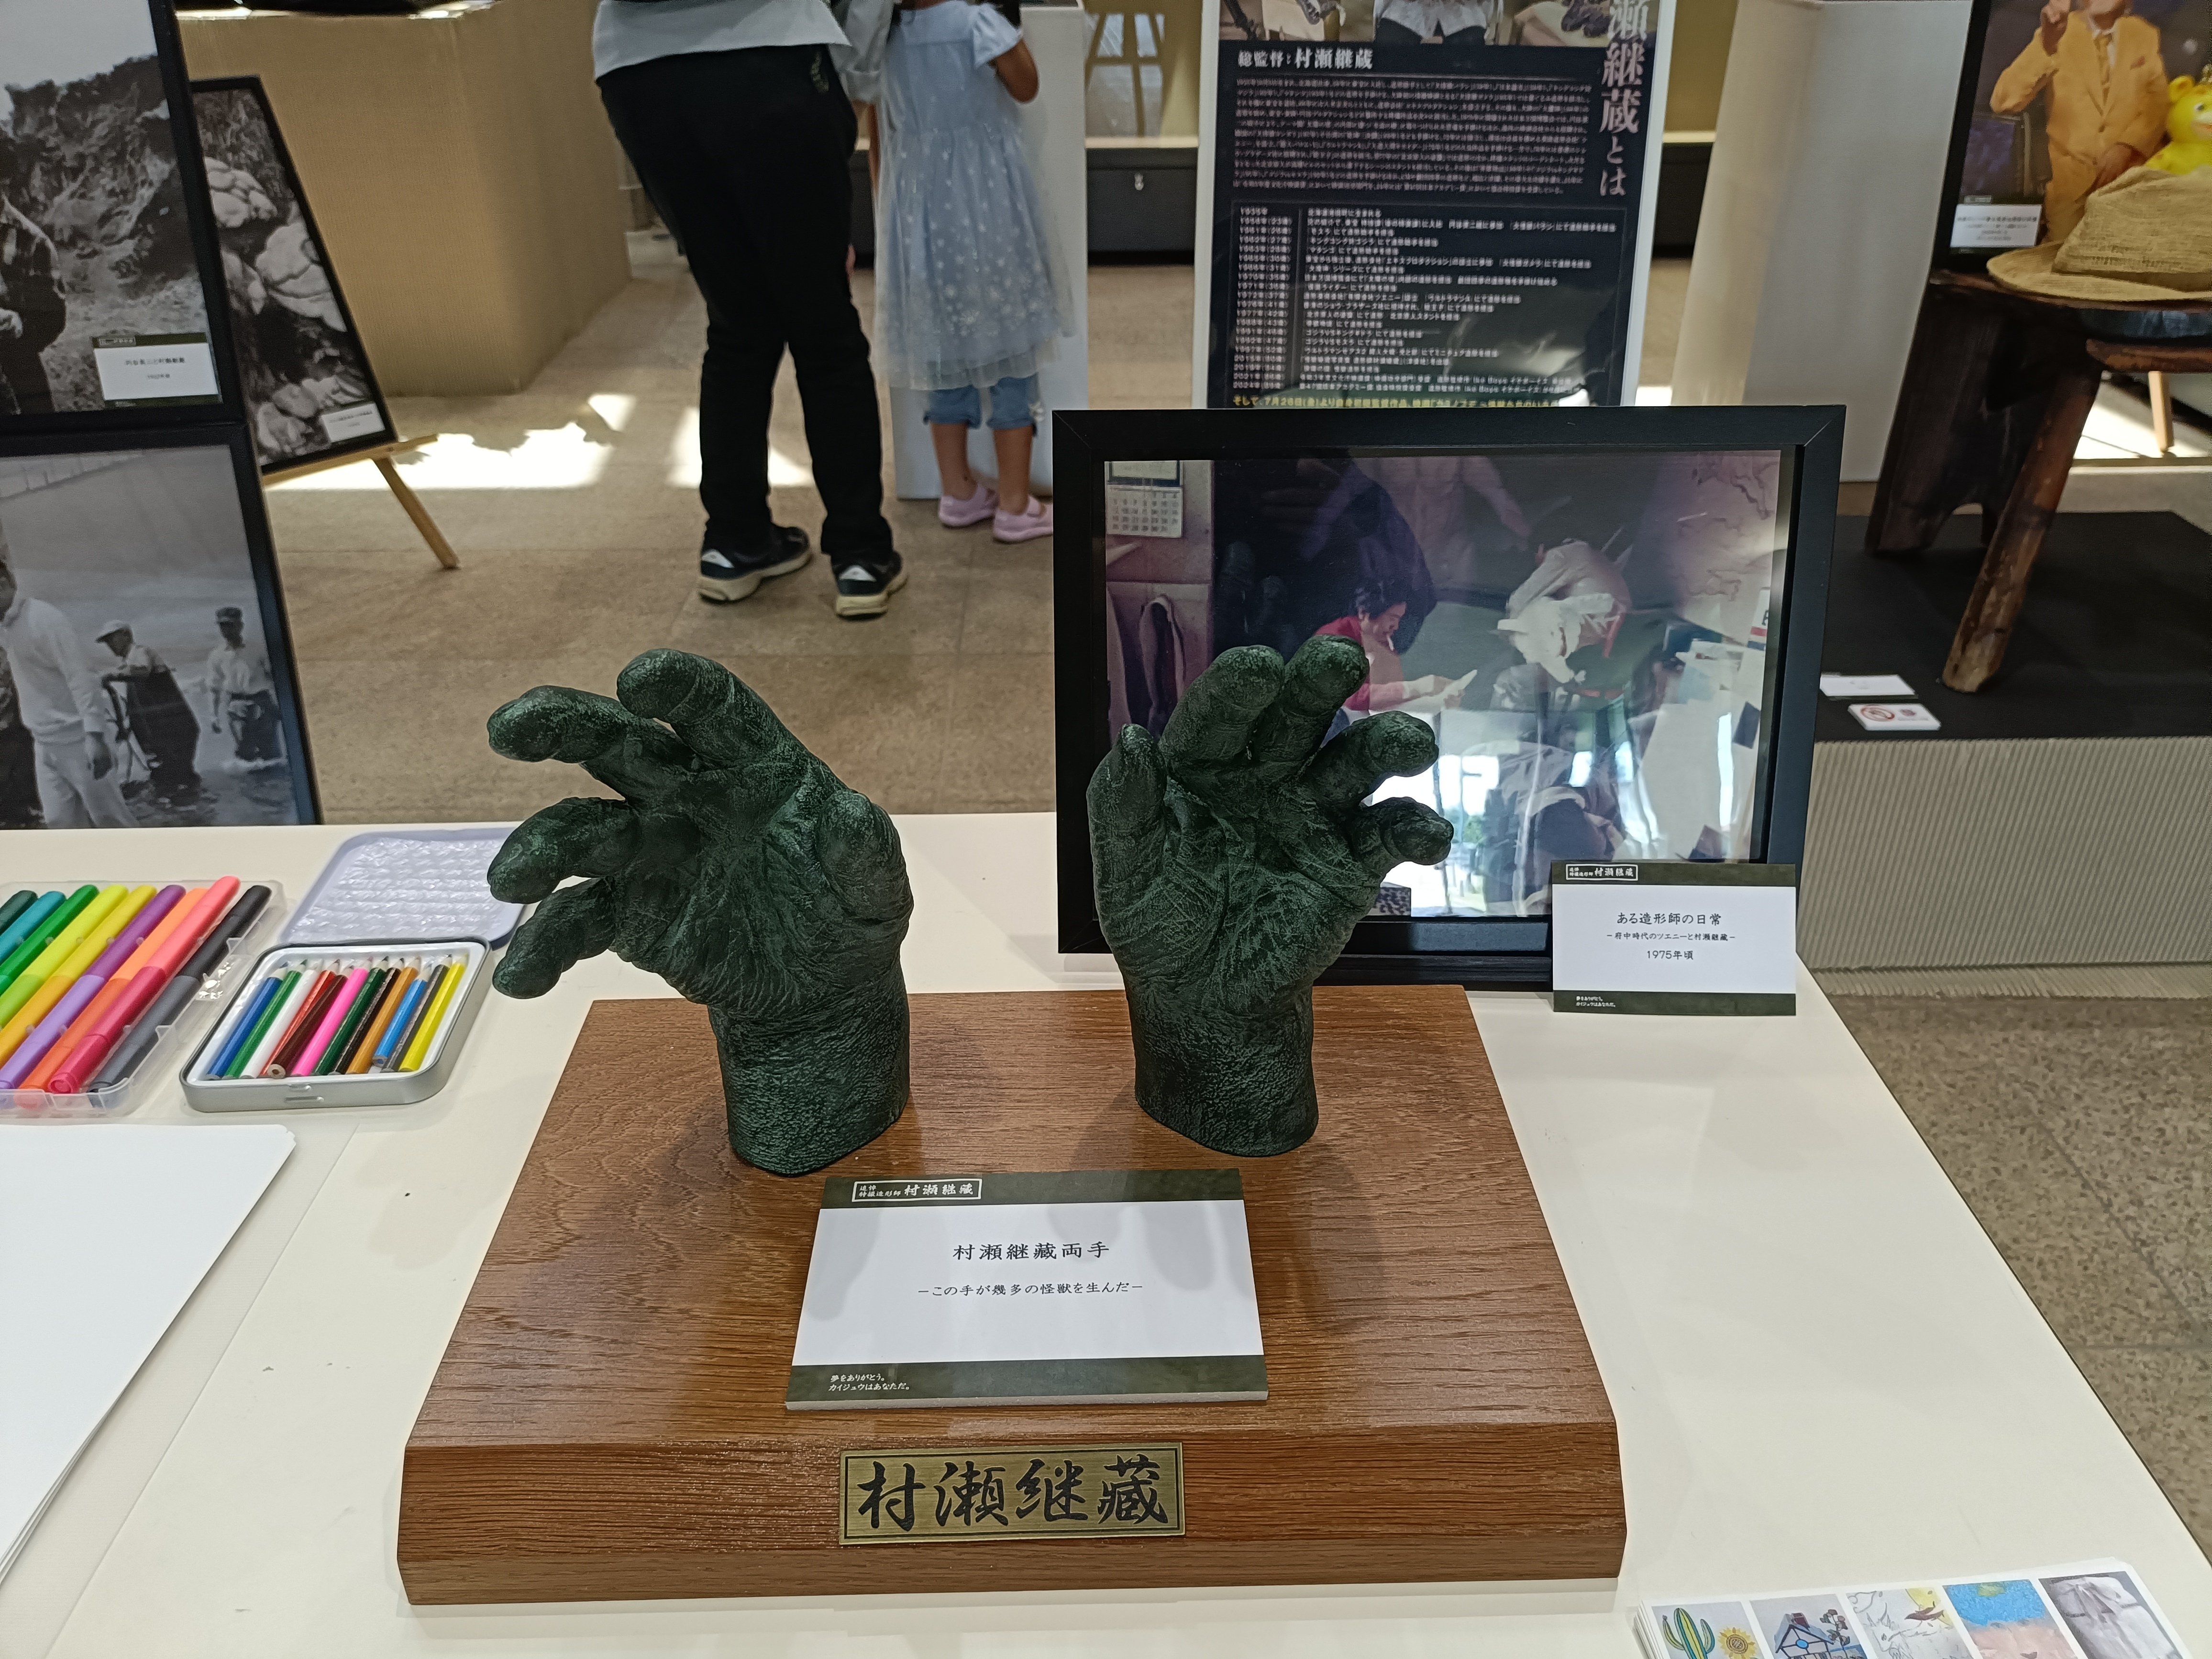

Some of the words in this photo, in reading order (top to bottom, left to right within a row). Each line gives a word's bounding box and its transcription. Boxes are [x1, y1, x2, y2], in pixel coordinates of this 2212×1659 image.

[1617, 912, 1722, 926] ある造形師の日常
[1647, 950, 1694, 960] 1975年頃
[830, 1373, 885, 1382] 夢をありがとう。
[828, 1382, 910, 1392] カイジュウはあなただ。
